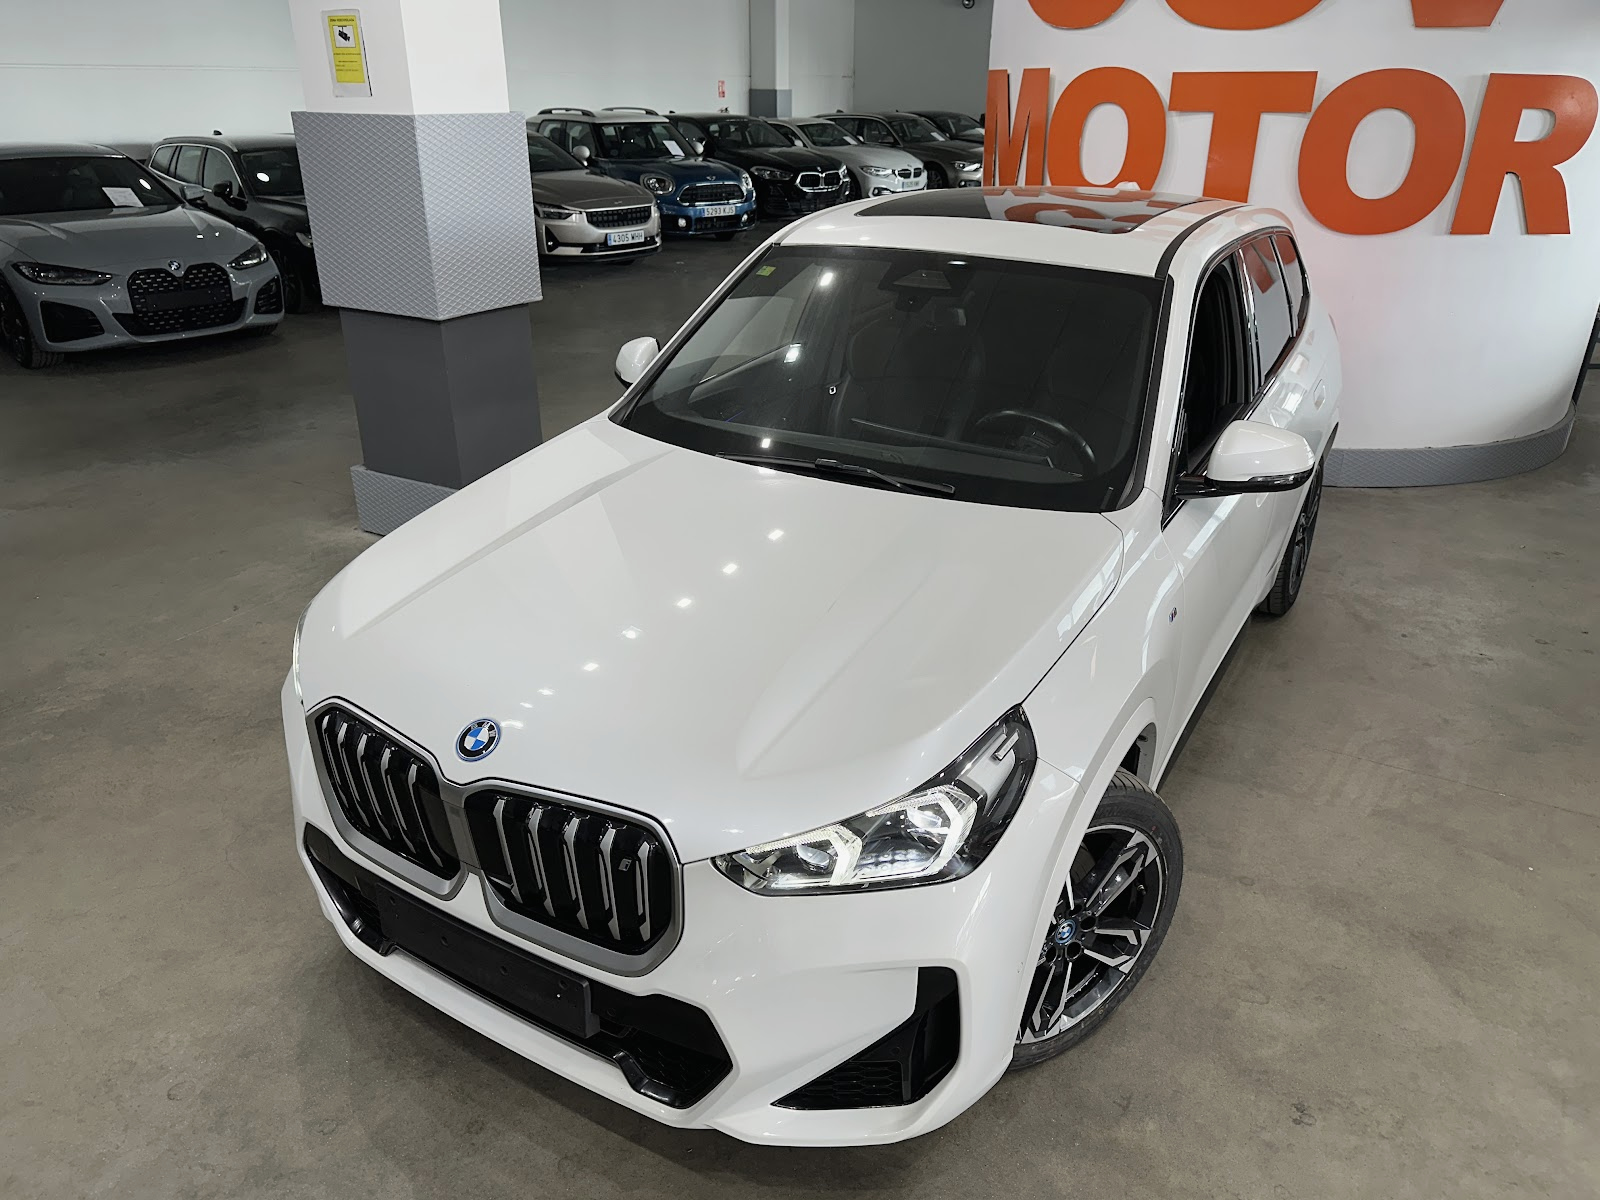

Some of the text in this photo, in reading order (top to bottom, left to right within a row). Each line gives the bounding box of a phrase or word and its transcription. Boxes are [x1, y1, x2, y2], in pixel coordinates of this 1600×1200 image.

[983, 66, 1599, 235] MOTOR
[706, 207, 721, 216] 5293
[613, 233, 629, 243] 4305
